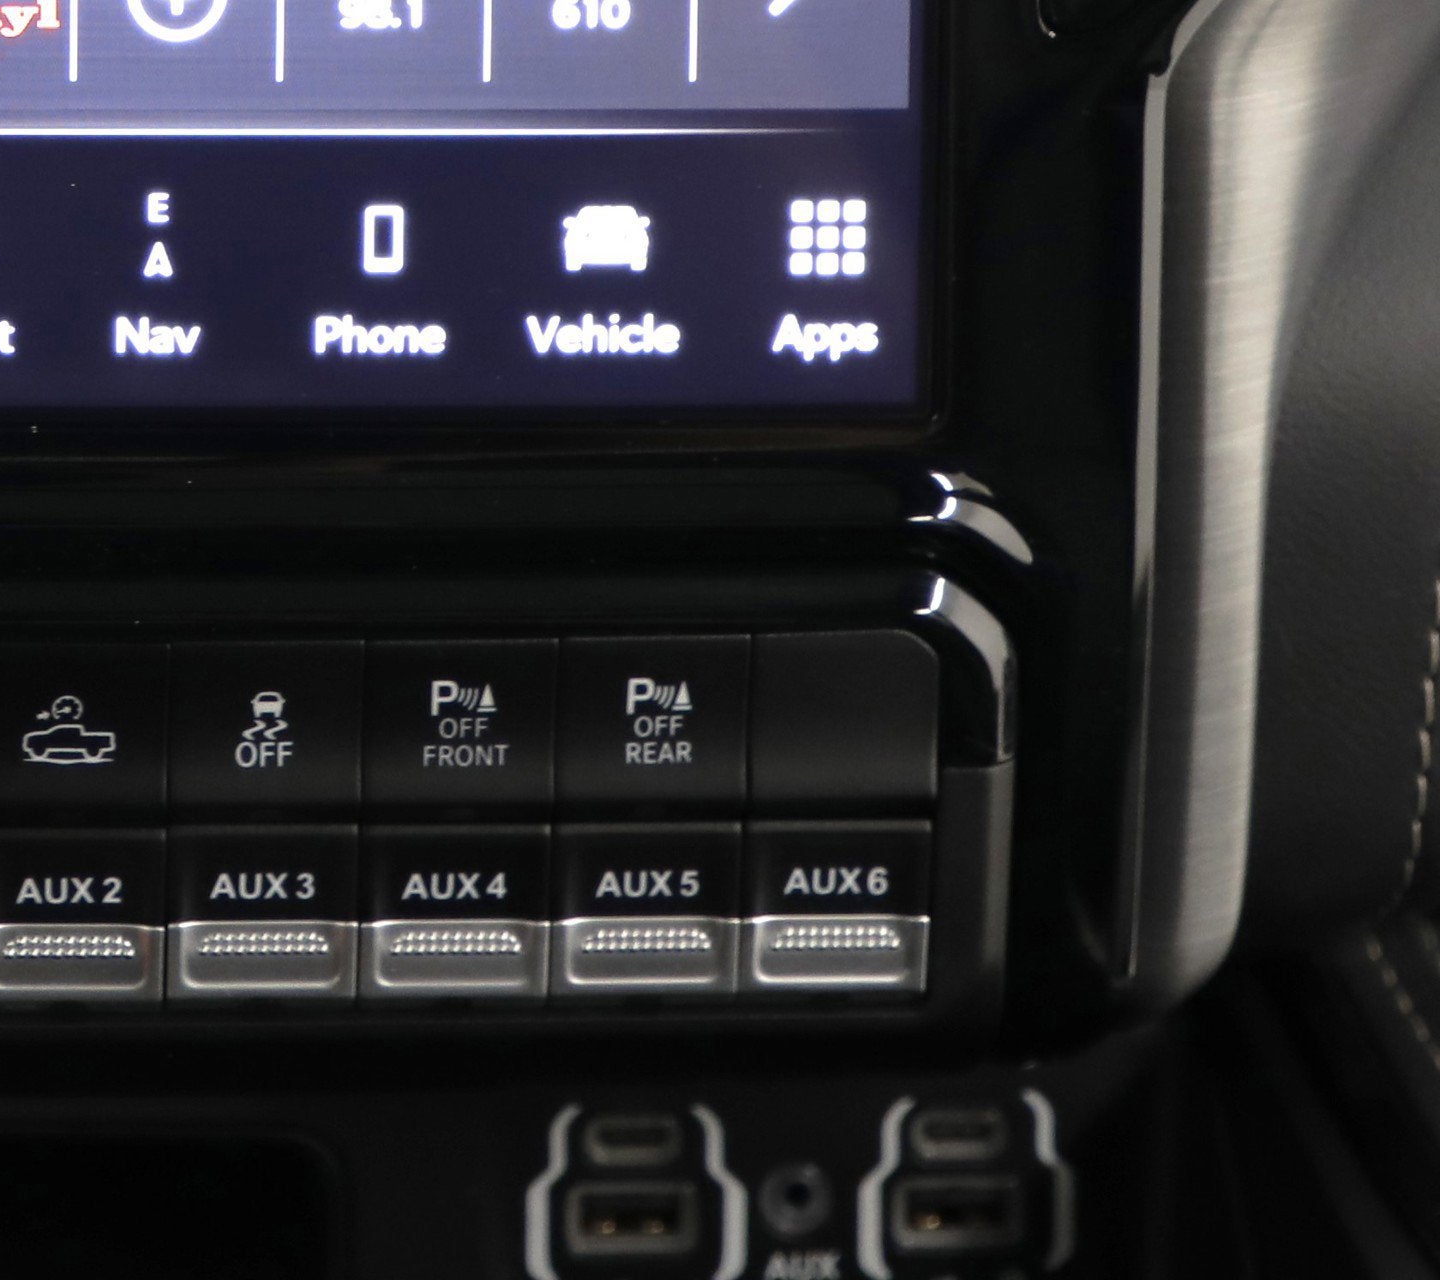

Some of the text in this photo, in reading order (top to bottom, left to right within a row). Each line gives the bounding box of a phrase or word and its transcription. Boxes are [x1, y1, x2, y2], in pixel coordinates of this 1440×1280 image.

[115, 318, 201, 355] Nav
[314, 316, 447, 355] Phone
[526, 313, 681, 355] Vehicle
[772, 314, 878, 361] Apps
[439, 718, 488, 738] OFF
[634, 716, 684, 737] OFF
[234, 742, 293, 767] OFF
[422, 745, 509, 767] FRONT
[625, 742, 692, 764] REAR
[15, 876, 122, 905] AUX 2
[209, 872, 315, 901] AUX 3
[402, 871, 507, 900] AUX 4
[595, 870, 700, 899] AUX 5
[783, 867, 888, 896] AUX 6
[765, 1251, 840, 1280] AUX
